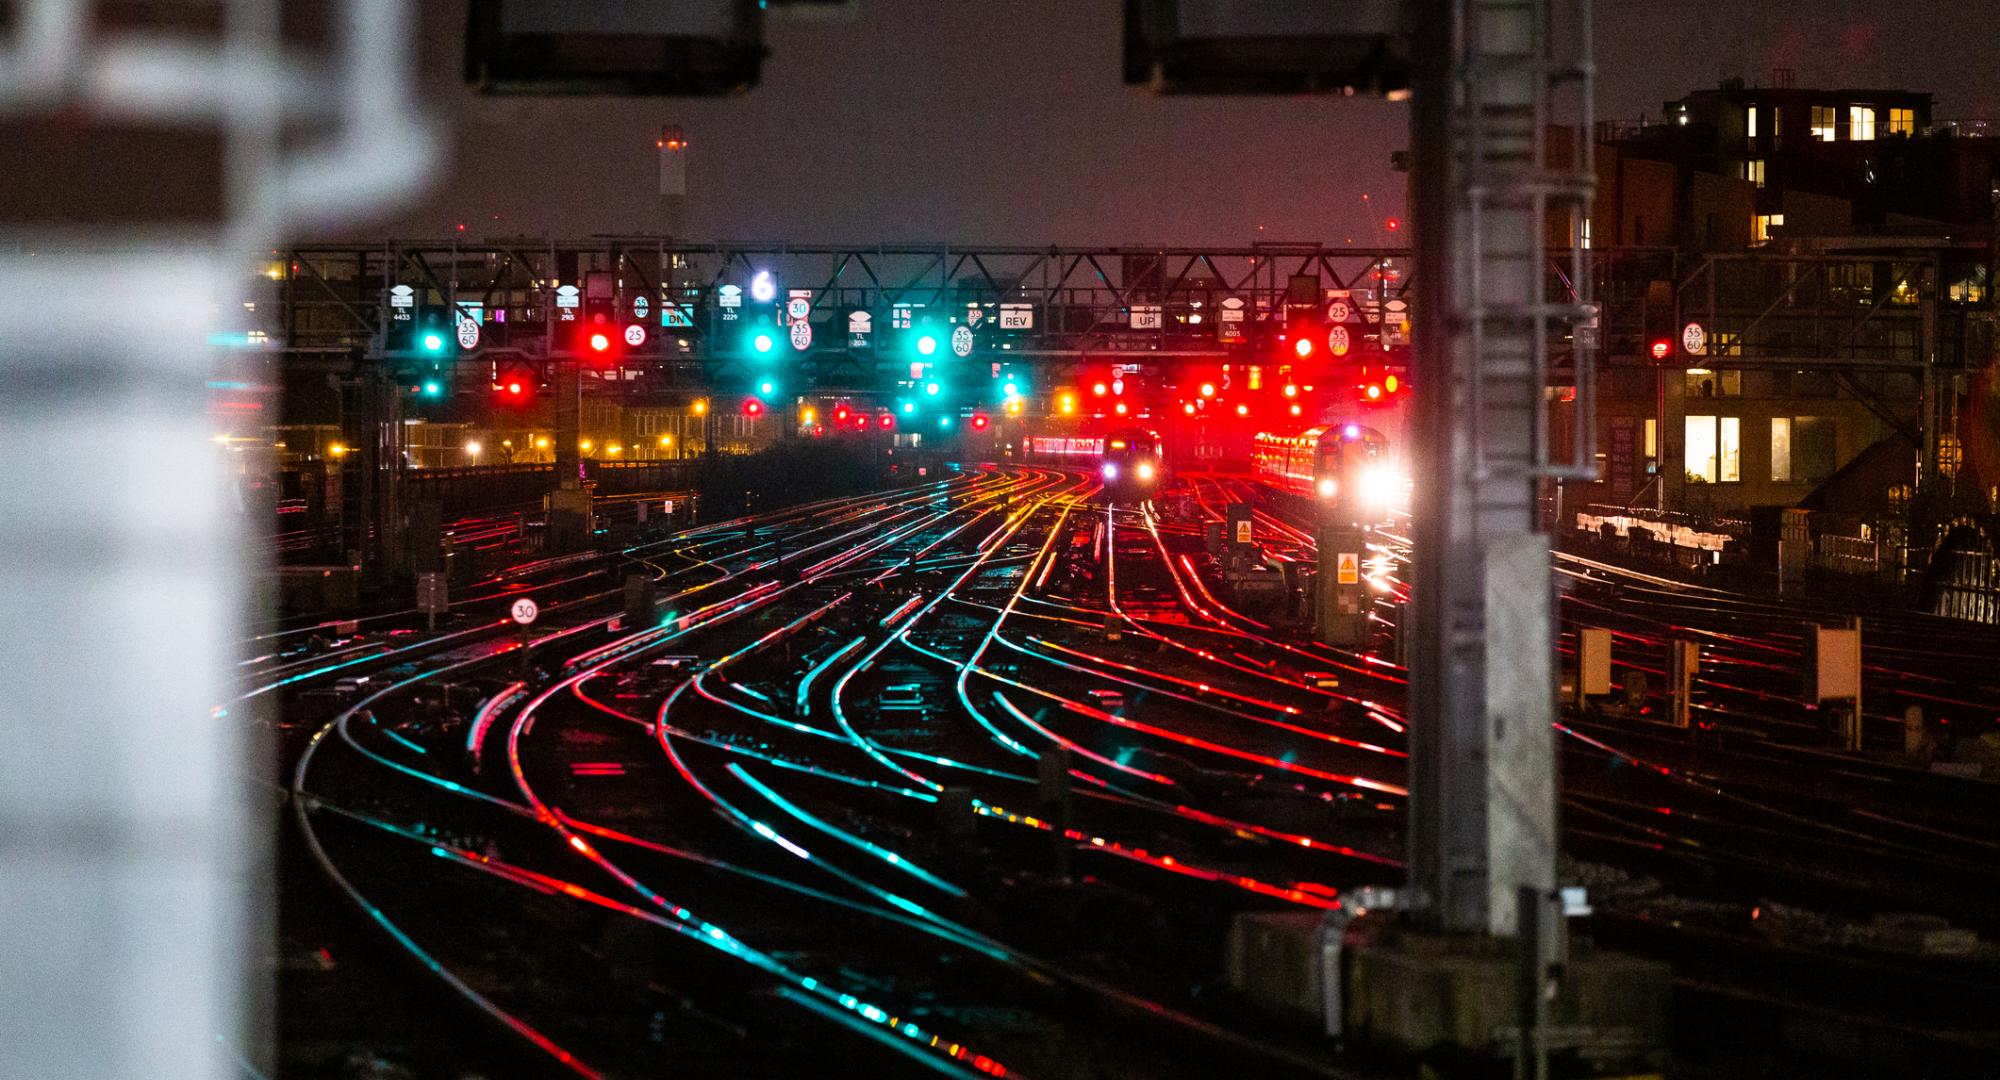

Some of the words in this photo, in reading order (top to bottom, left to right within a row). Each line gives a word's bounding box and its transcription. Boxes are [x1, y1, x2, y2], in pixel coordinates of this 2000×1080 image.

[752, 271, 774, 300] 6
[792, 304, 806, 313] 30
[1332, 307, 1346, 318] 25
[669, 316, 684, 324] DN
[1005, 317, 1027, 326] REV
[1139, 316, 1154, 326] UP
[462, 323, 475, 333] 35
[794, 324, 808, 334] 35
[1687, 327, 1701, 338] 35
[628, 330, 642, 341] 25
[955, 330, 969, 340] 35
[1332, 329, 1346, 340] 35
[462, 335, 475, 345] 60
[794, 336, 808, 346] 60
[955, 343, 969, 353] 60
[1332, 343, 1346, 352] 60
[1687, 341, 1701, 350] 60
[517, 605, 534, 618] 30
